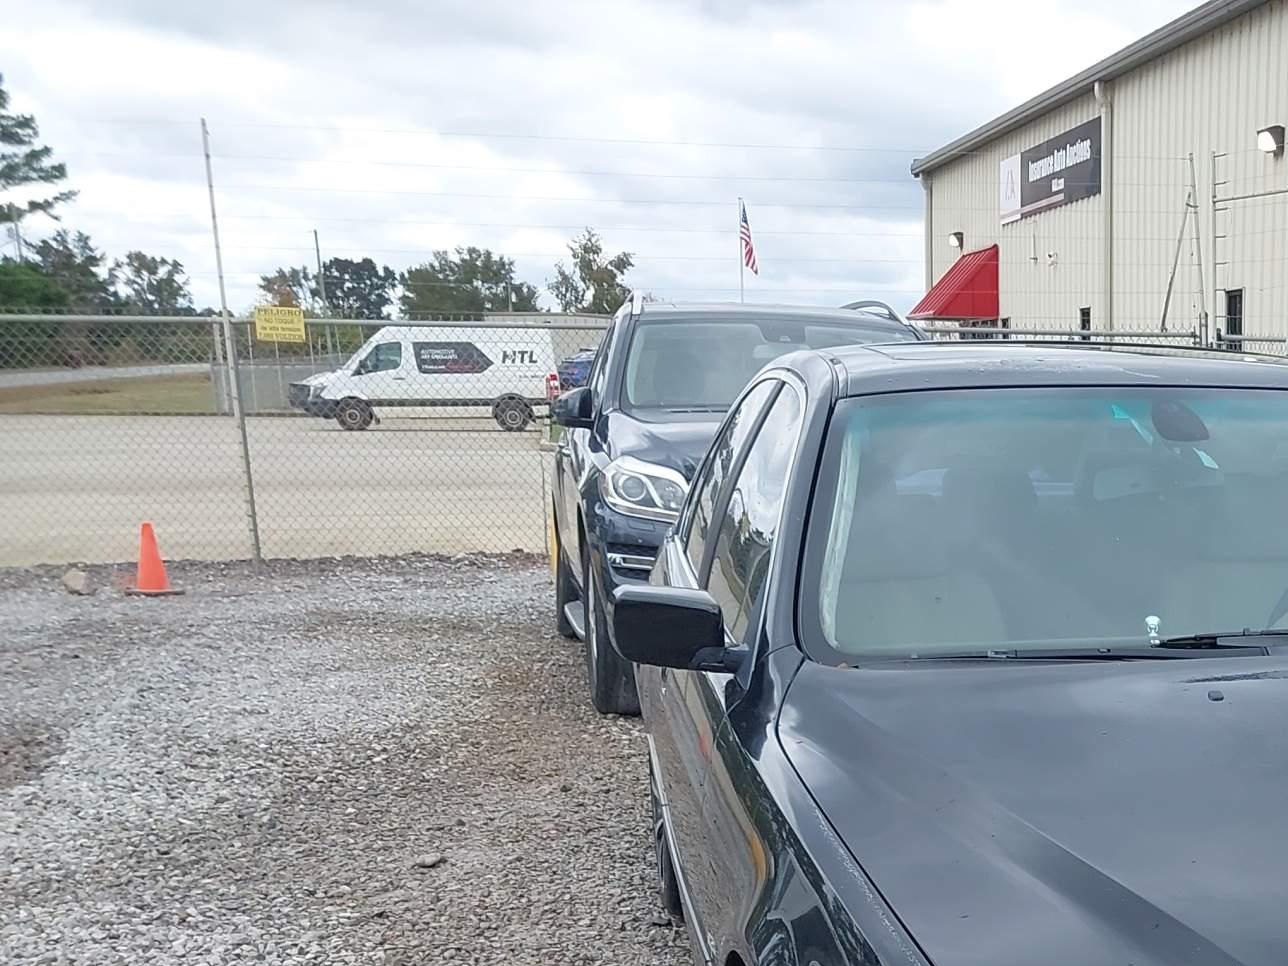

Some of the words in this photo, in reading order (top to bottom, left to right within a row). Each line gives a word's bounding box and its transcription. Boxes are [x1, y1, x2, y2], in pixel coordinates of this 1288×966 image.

[1029, 154, 1053, 183] Insurance
[1054, 149, 1066, 173] Auto
[1067, 139, 1091, 168] Auctions
[257, 308, 302, 316] PELIGRO
[501, 350, 538, 364] HTL
